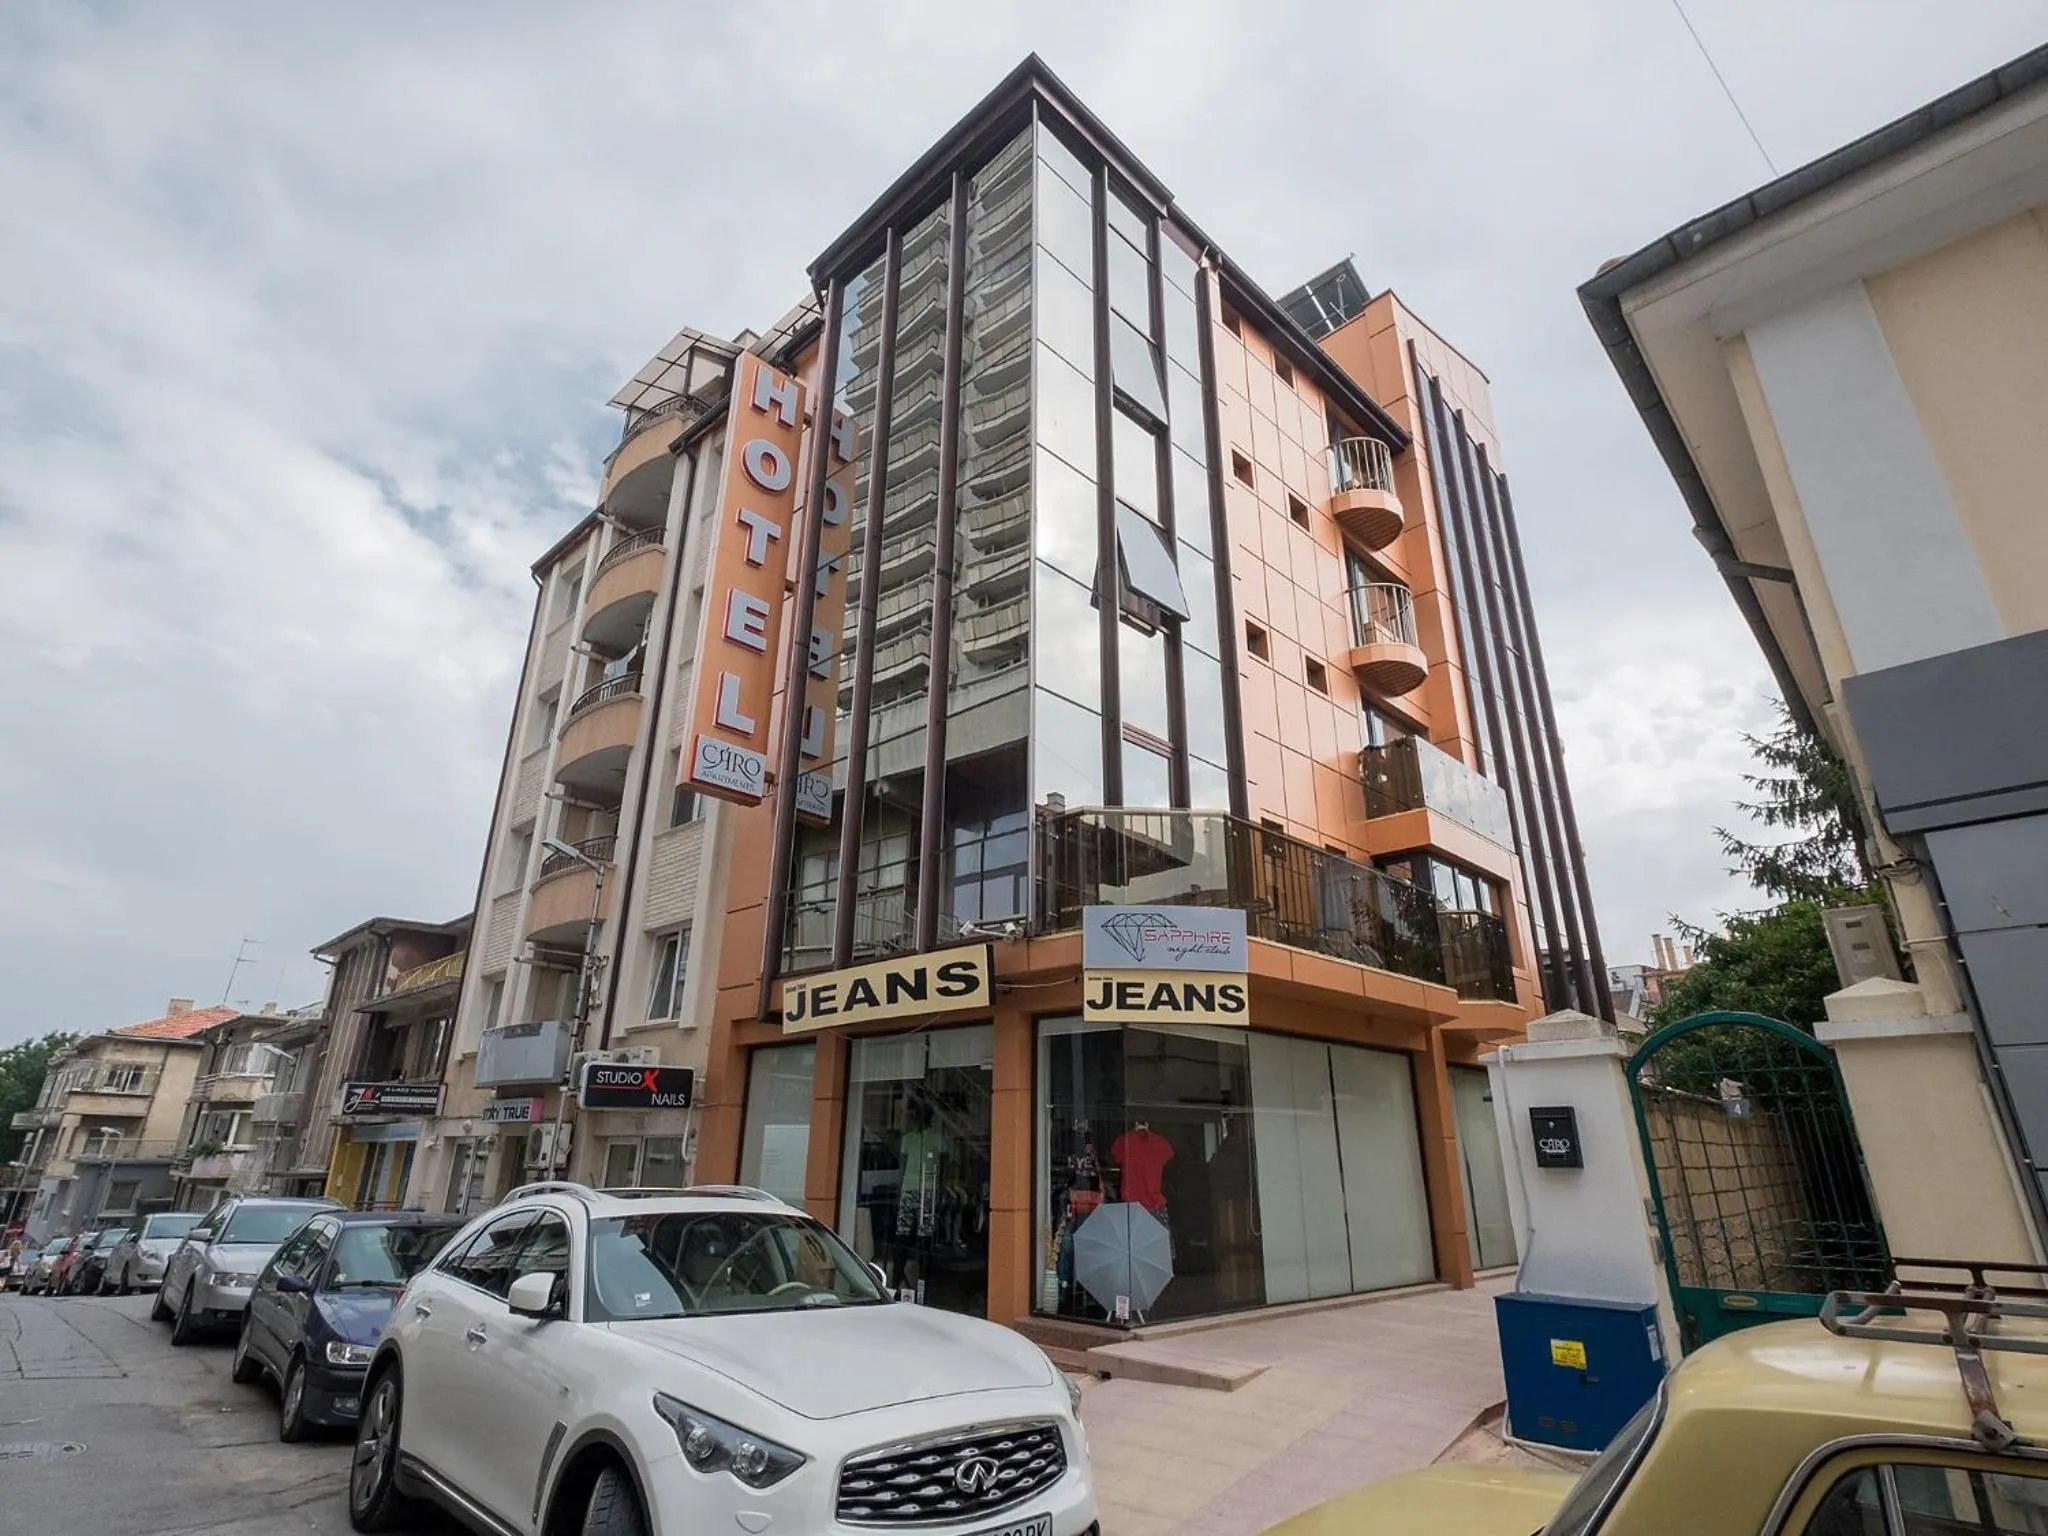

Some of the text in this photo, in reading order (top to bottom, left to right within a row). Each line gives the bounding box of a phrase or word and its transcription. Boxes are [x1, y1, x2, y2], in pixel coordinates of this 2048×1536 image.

[713, 364, 799, 736] HOTEL
[701, 770, 757, 792] APARTMENTS
[1144, 929, 1231, 944] SAPPHIRE
[1167, 943, 1231, 961] night club
[786, 961, 981, 1022] JEANS
[1086, 981, 1246, 1014] JEANS
[595, 1071, 642, 1085] STUDIO
[651, 1093, 686, 1106] NAILS
[503, 1105, 531, 1120] TRUE
